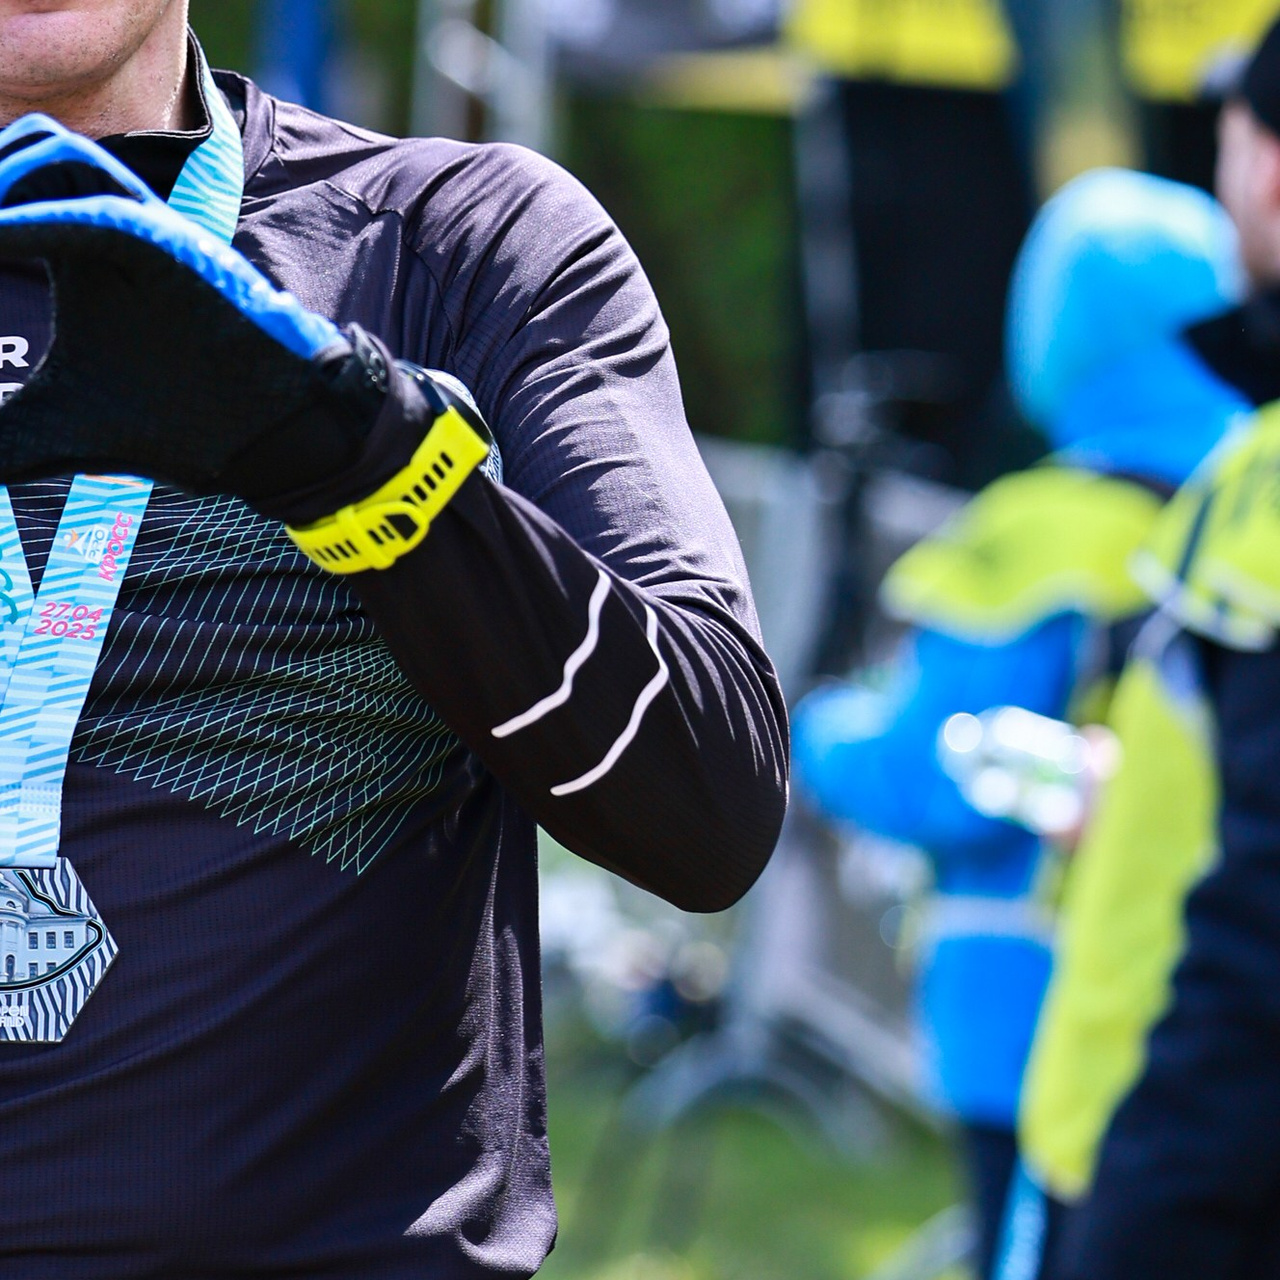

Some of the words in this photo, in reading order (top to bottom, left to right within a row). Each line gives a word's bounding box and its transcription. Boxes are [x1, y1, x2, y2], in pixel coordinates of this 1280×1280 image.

[88, 528, 107, 560] PRO
[98, 512, 133, 582] КРОСС
[39, 602, 104, 622] 27.04
[34, 619, 98, 640] 2025
